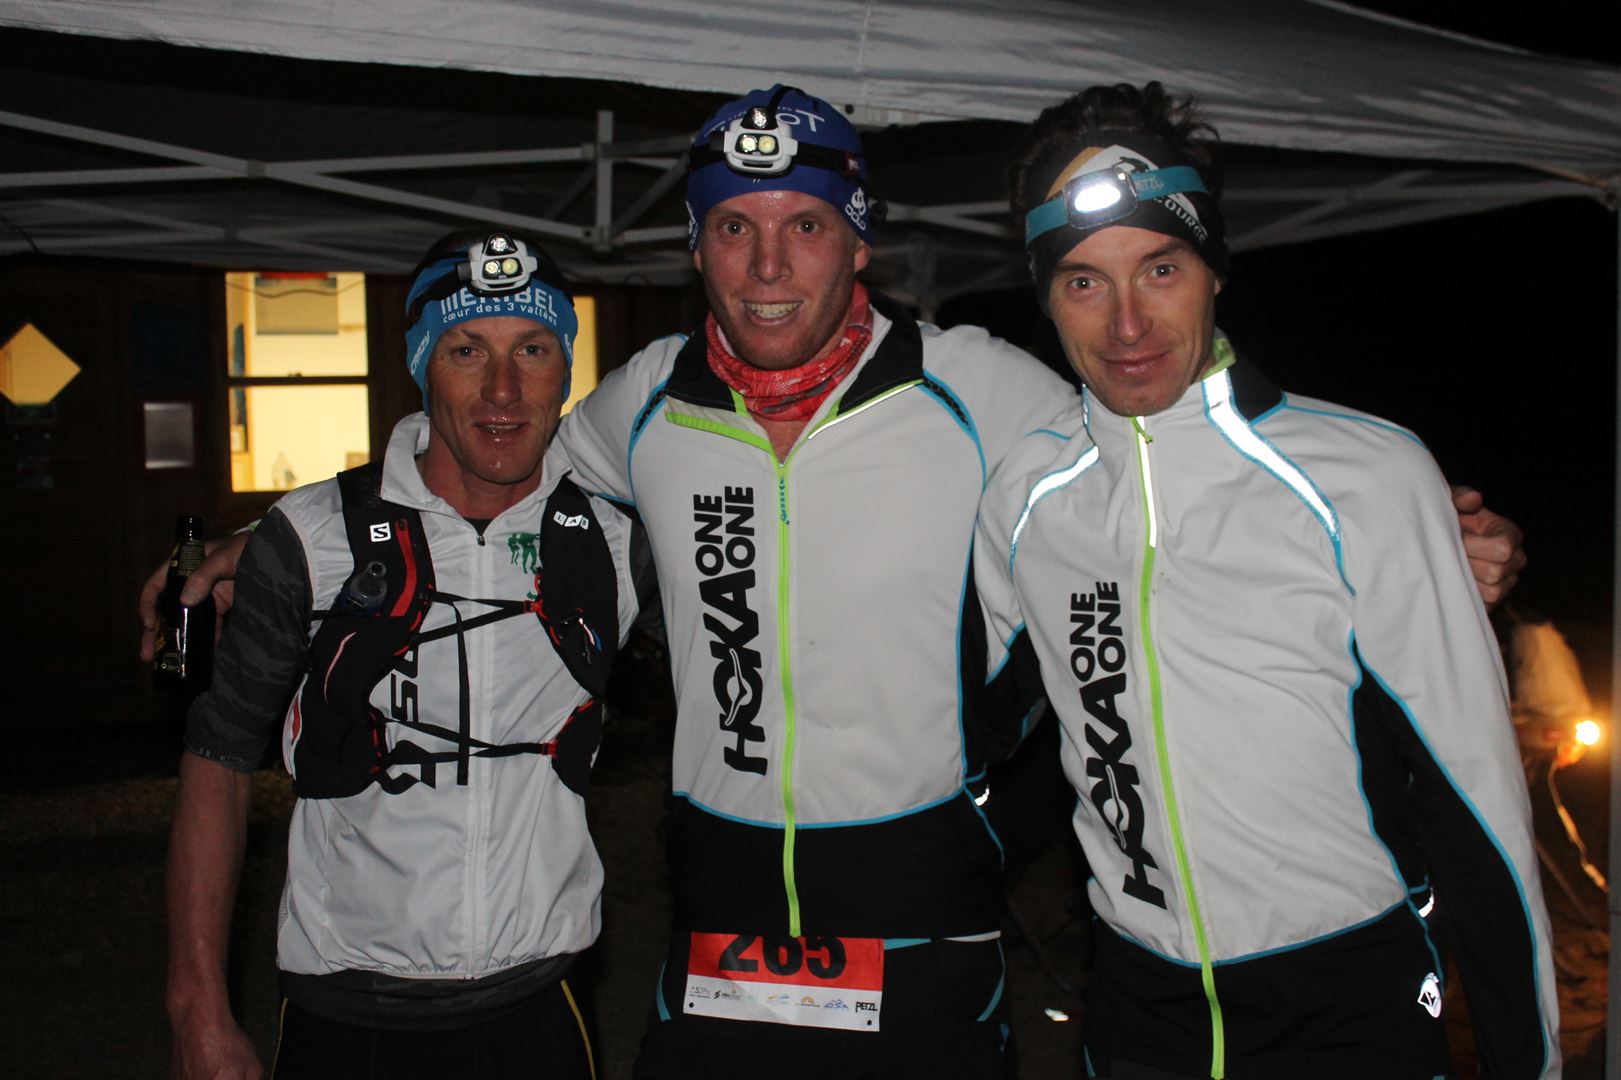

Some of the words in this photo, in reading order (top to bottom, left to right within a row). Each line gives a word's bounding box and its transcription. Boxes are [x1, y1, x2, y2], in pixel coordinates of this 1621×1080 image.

[476, 302, 501, 313] des
[507, 301, 515, 312] 3
[693, 494, 724, 576] ONE
[724, 486, 756, 569] ONE
[1069, 592, 1096, 682] ONE
[1095, 581, 1127, 673] ONE
[698, 569, 768, 776] HOKA
[1079, 672, 1168, 911] HOKA
[855, 1001, 878, 1013] PETZL
